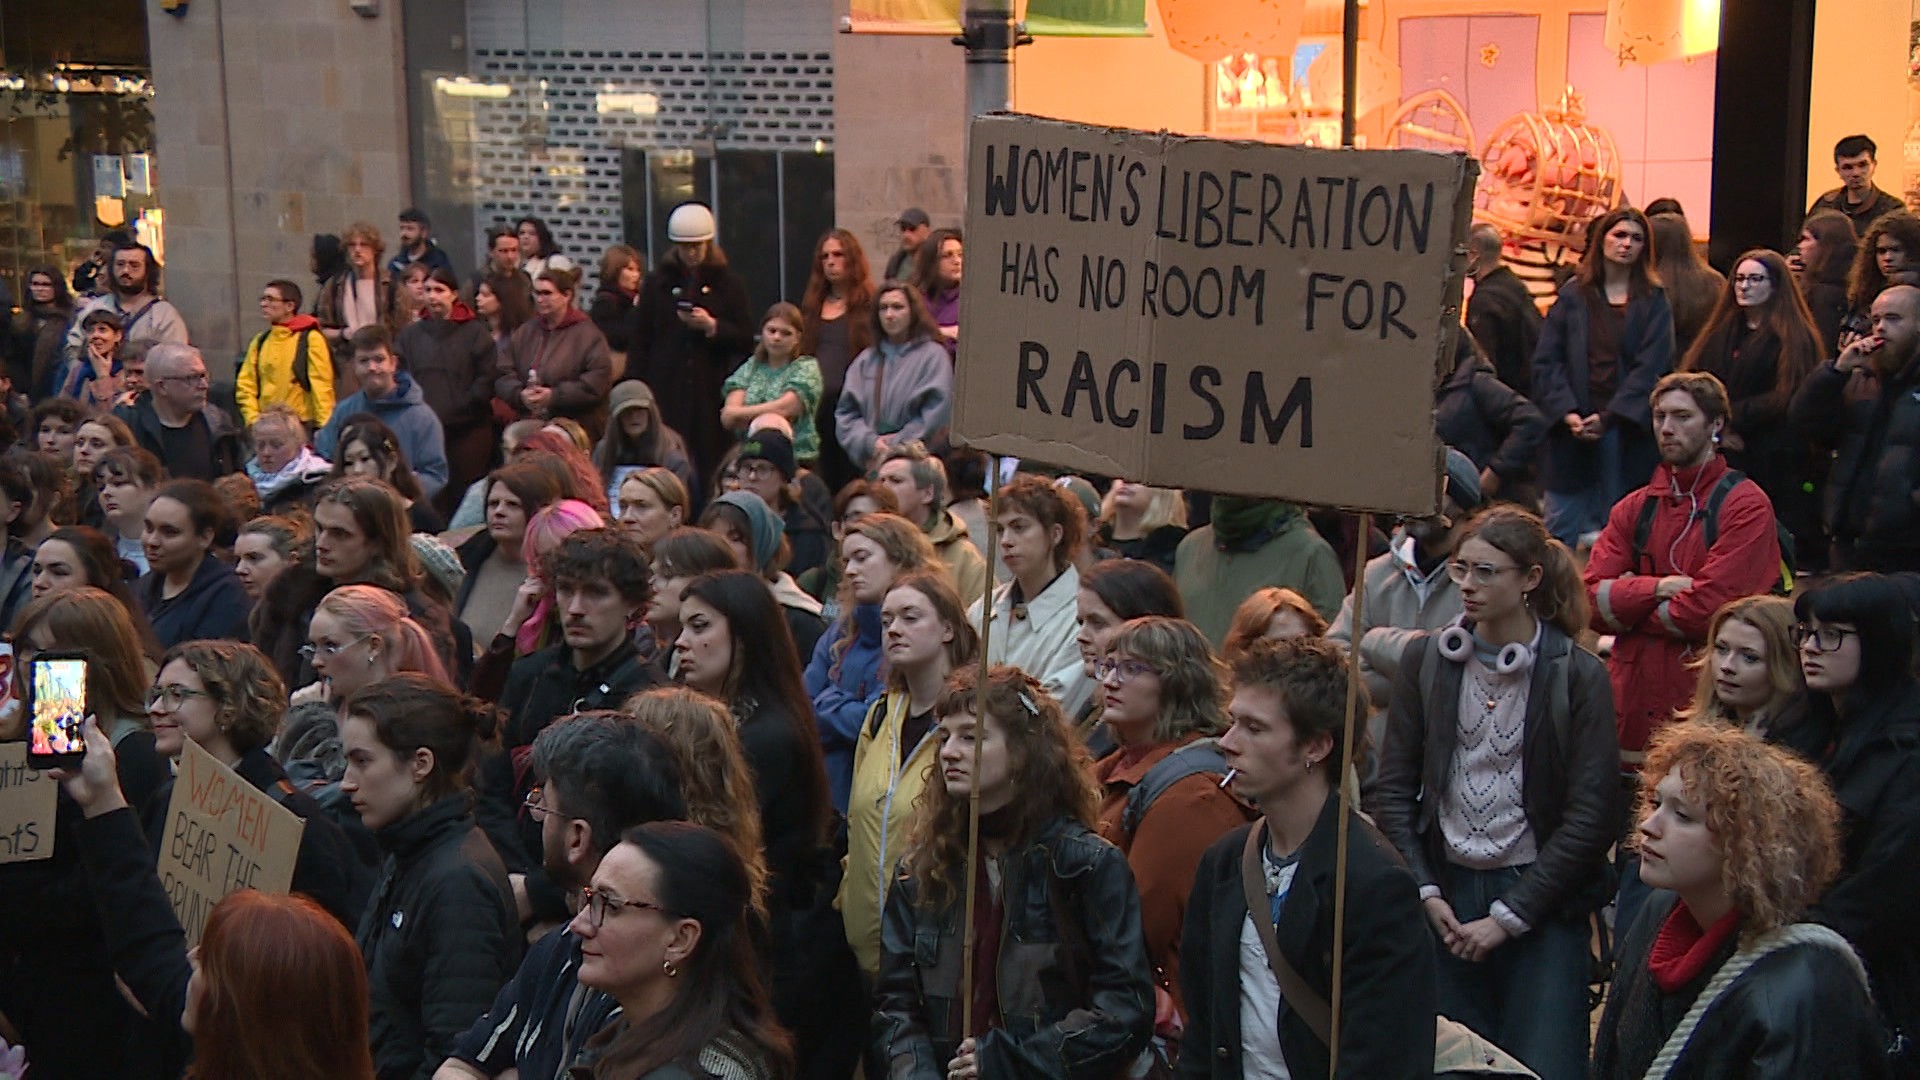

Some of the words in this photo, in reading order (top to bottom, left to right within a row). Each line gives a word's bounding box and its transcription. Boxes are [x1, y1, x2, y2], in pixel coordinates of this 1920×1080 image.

[984, 144, 1147, 227] WOMEN'S
[1155, 165, 1434, 254] LIBERATION
[1000, 241, 1060, 302] HAS
[1078, 254, 1127, 312] NO
[1141, 260, 1266, 325] ROOM
[1305, 272, 1417, 339] FOR
[1015, 340, 1313, 448] RACISM
[171, 811, 217, 883] BEAR
[189, 754, 273, 853] WOMEN
